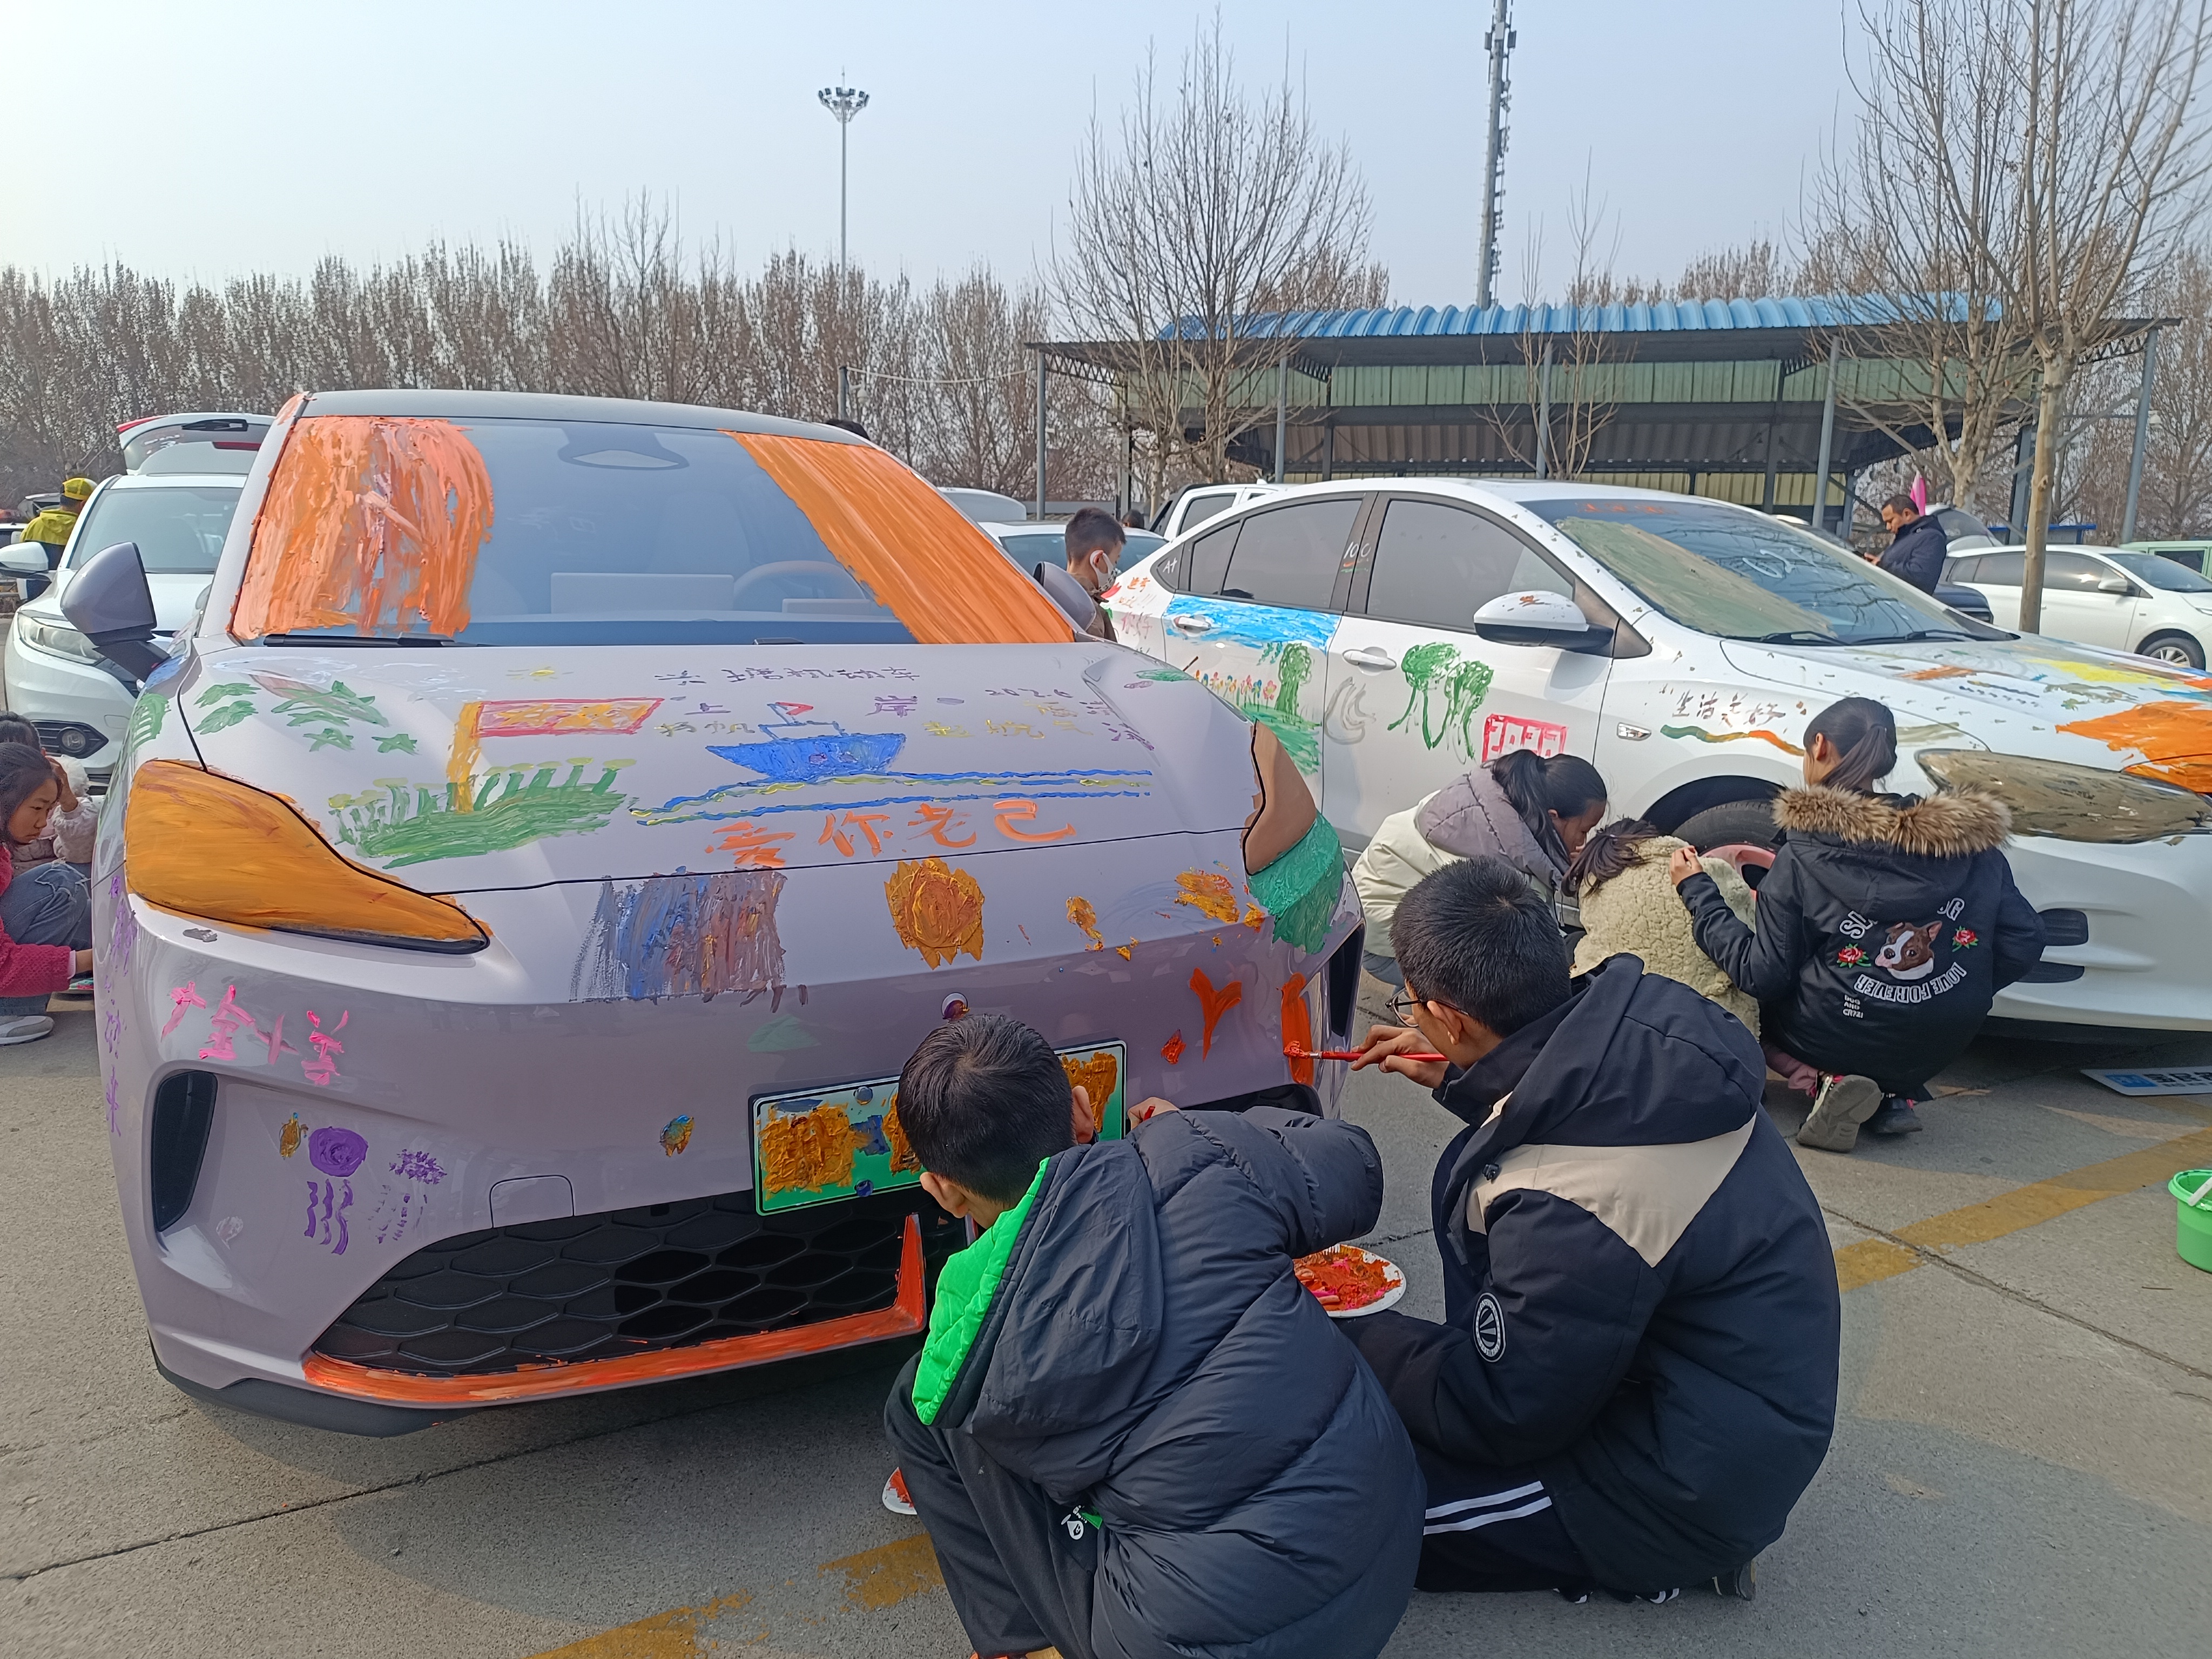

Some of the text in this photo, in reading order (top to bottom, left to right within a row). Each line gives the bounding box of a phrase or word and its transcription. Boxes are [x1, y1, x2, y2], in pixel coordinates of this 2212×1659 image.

[1853, 961, 1967, 1004] LOVE FOREVER
[1844, 1002, 1860, 1010] AND
